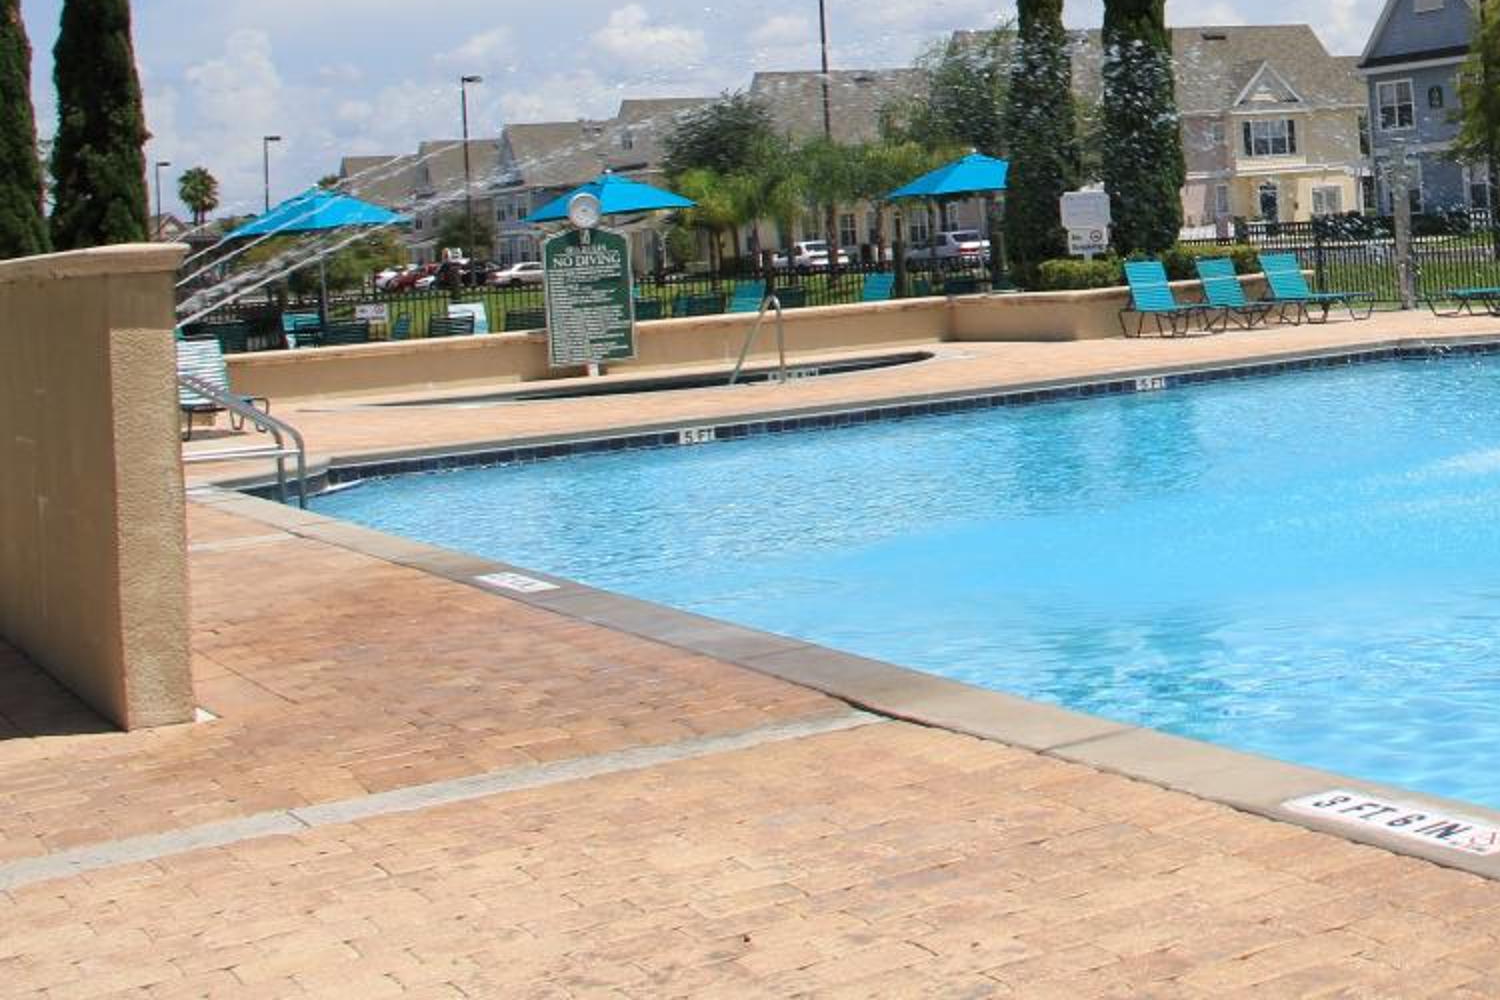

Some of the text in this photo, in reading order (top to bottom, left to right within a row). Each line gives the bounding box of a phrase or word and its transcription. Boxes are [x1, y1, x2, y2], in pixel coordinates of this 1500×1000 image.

[552, 251, 621, 269] NO DIVING
[684, 427, 713, 443] 5 FT
[1312, 795, 1351, 808] 3
[1338, 802, 1398, 820] FT
[1386, 813, 1426, 827] 6
